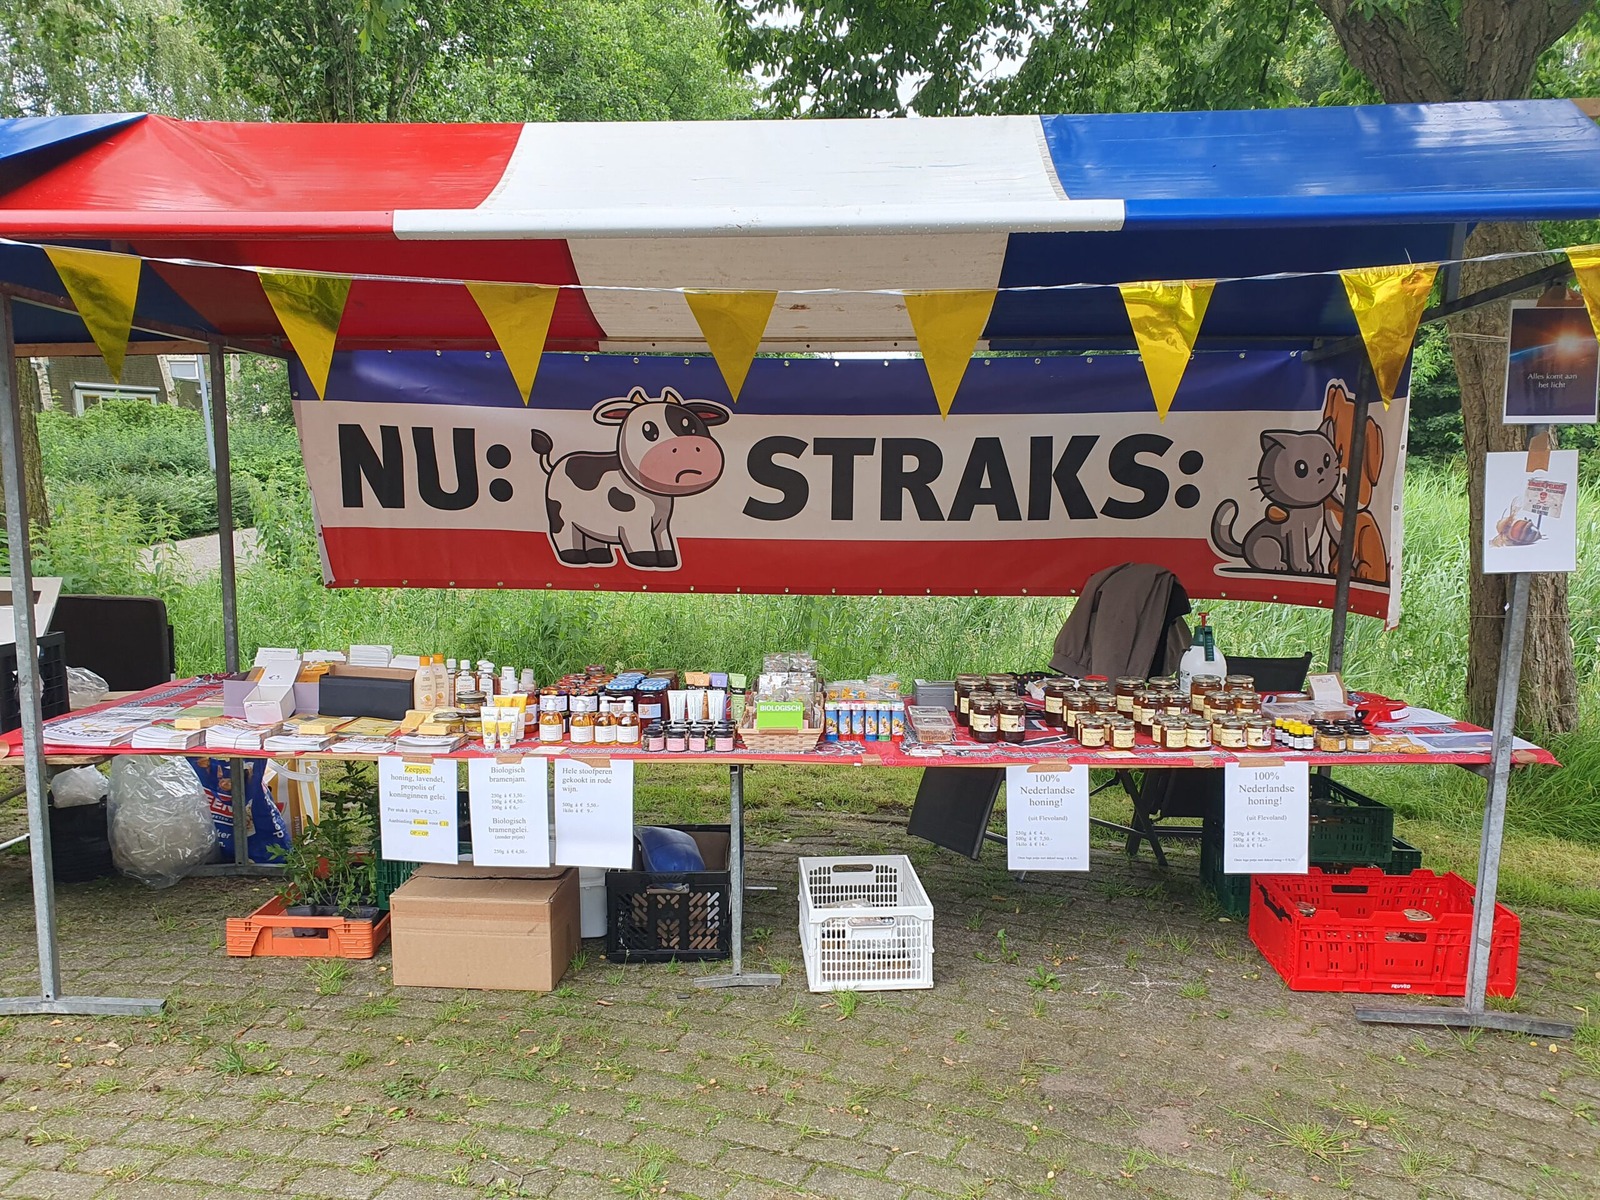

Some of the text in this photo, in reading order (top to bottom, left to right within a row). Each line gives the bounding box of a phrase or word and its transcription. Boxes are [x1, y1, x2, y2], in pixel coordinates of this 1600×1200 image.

[338, 424, 1204, 521] NU: STRAKS:
[760, 704, 801, 712] BIOLOGISCH
[404, 766, 431, 775] Zeepjes:
[491, 766, 525, 775] Biologisch
[578, 768, 613, 776] stoofperen
[390, 774, 445, 784] honing, lavendel,
[489, 776, 526, 784] bramenjam.
[1035, 774, 1060, 782] 100%
[1254, 772, 1280, 781] 100%
[400, 784, 427, 792] propolis
[562, 785, 578, 793] wijn.
[1020, 786, 1075, 795] Nederlandse
[1238, 784, 1295, 793] Nederlandse
[389, 791, 428, 801] koninginnen
[1029, 798, 1063, 808] honing!
[1247, 796, 1282, 807] honing!
[492, 817, 526, 826] Biologisch
[488, 826, 529, 834] bramengelei.
